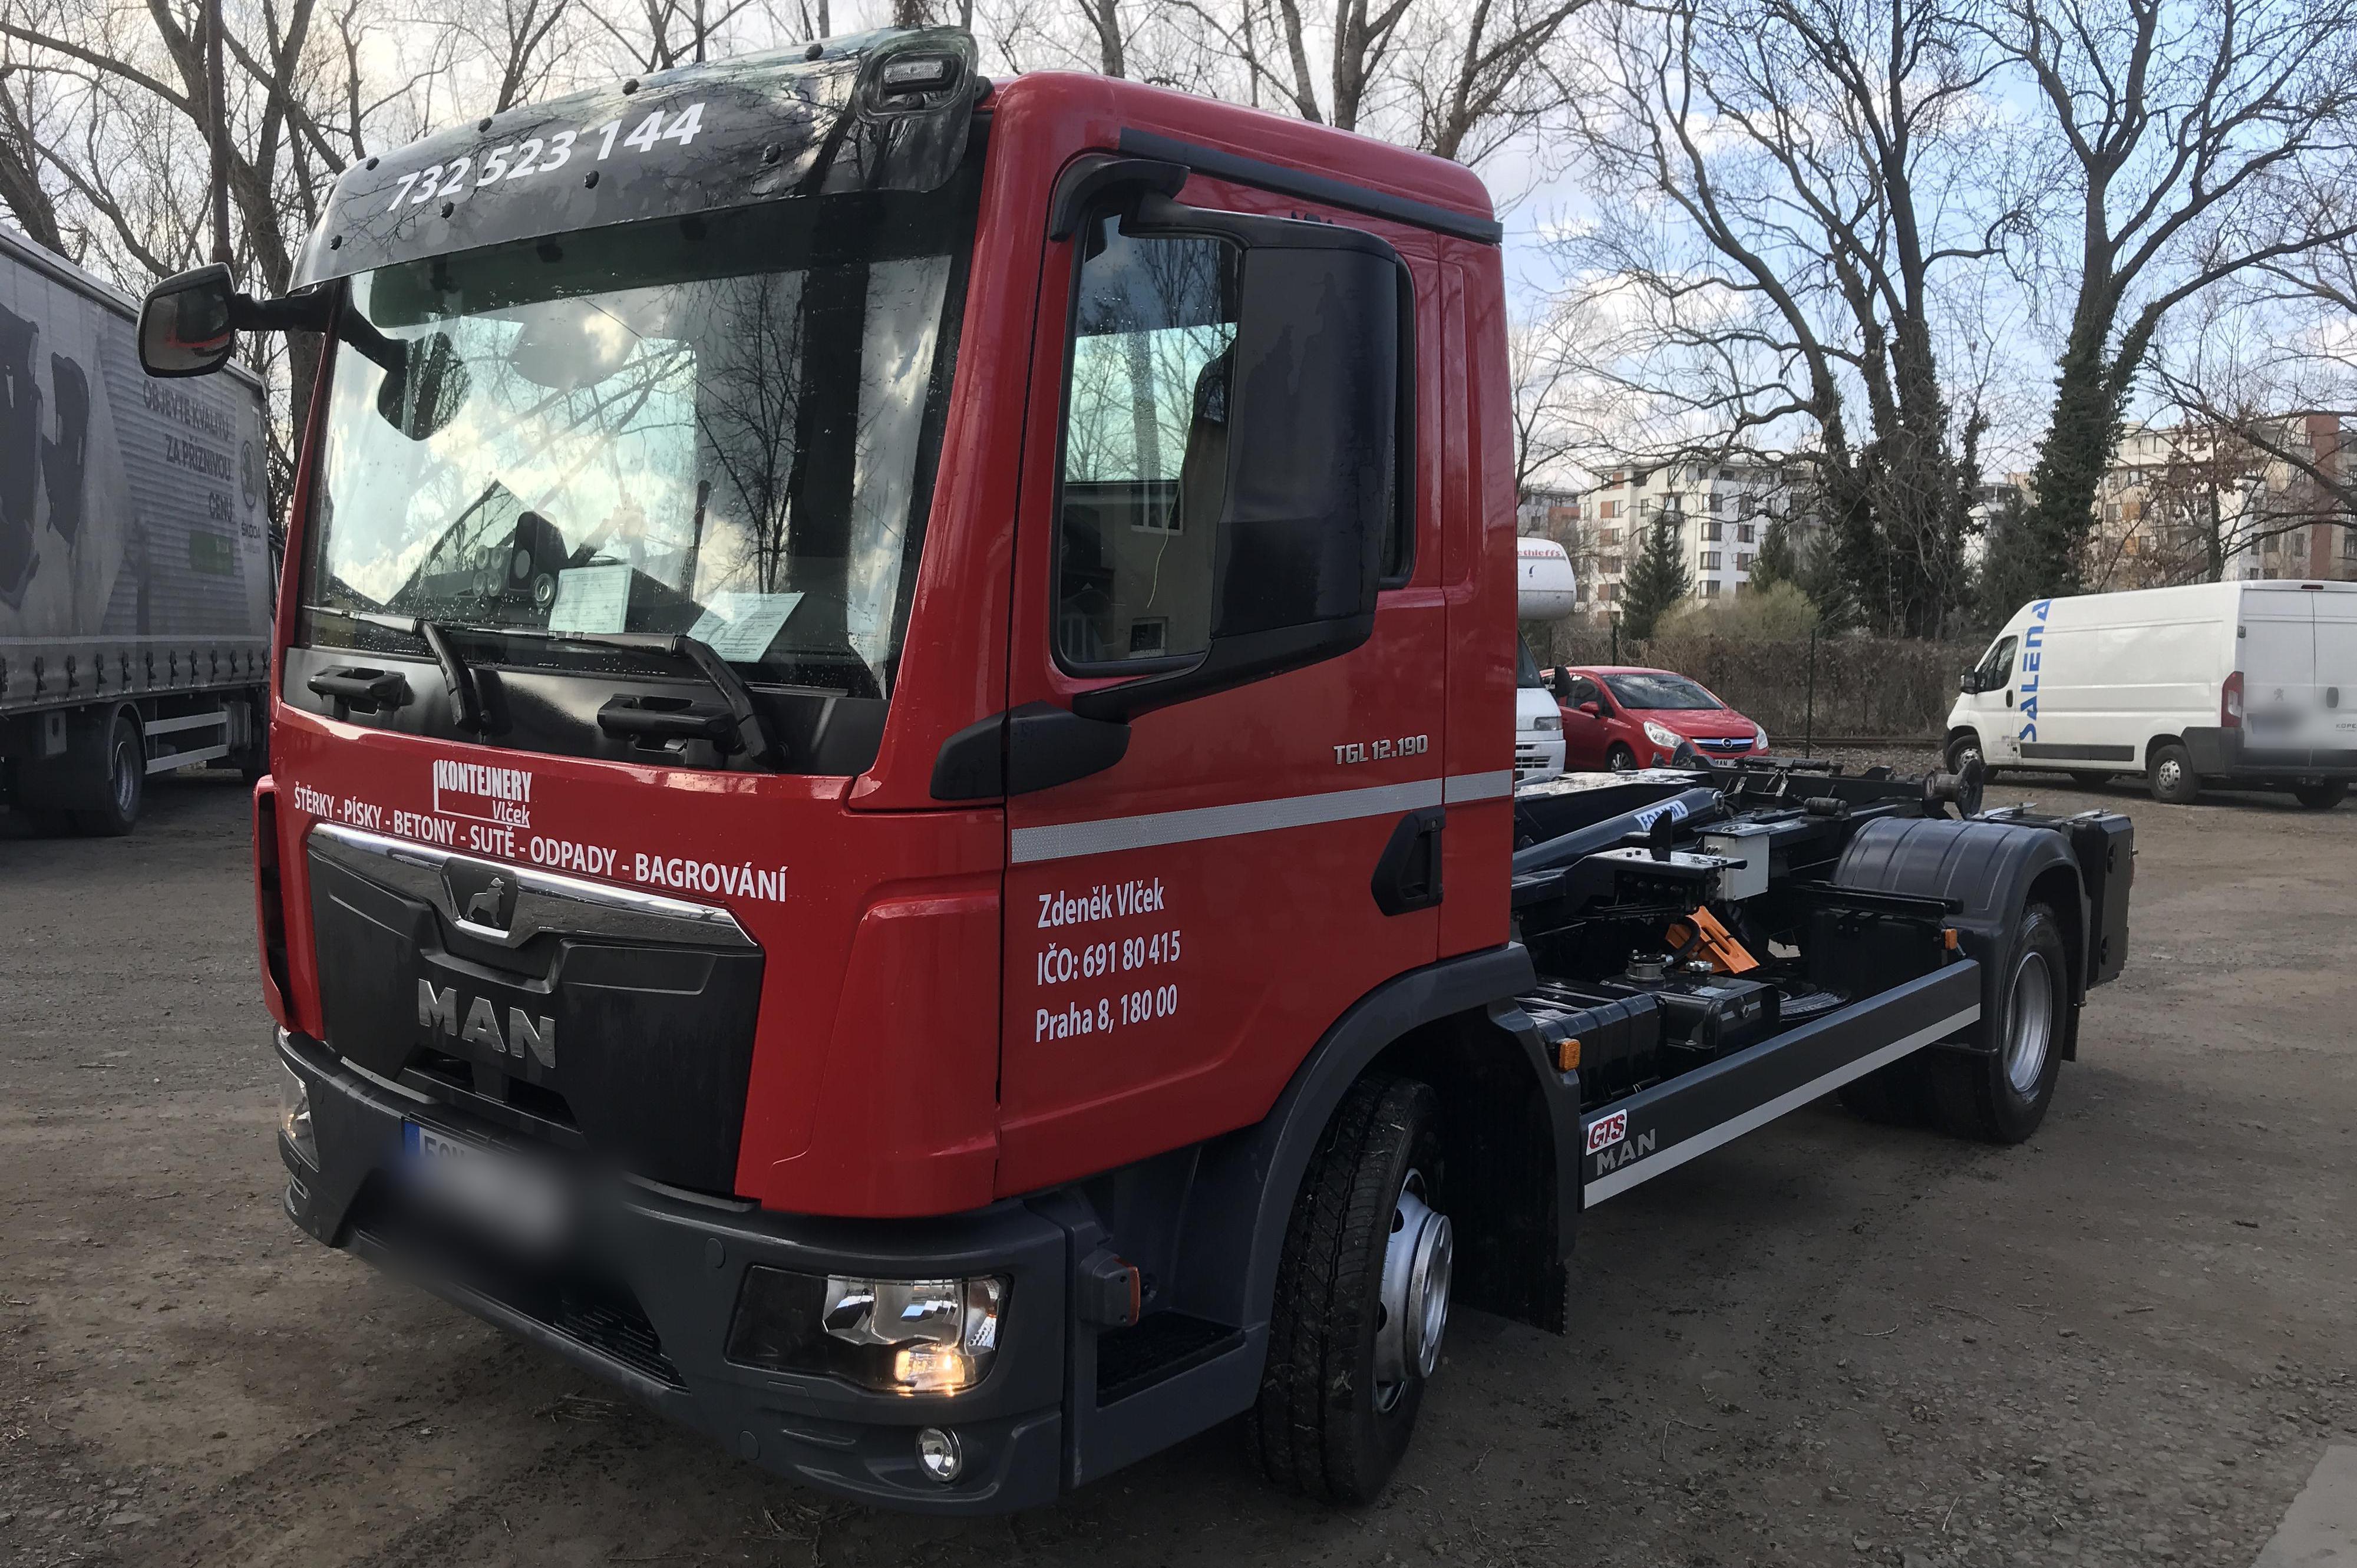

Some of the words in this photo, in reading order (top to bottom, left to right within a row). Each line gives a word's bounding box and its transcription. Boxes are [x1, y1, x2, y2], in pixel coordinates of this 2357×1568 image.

[387, 157, 471, 212] 732
[476, 130, 577, 187] 523
[597, 103, 706, 160] 144
[166, 433, 180, 465] ZA
[209, 491, 232, 522] CENU
[2018, 599, 2052, 742] SALENA
[1333, 743, 1368, 764] TGL
[1372, 734, 1428, 760] 12.190
[438, 759, 532, 803] KONTEJNERY
[492, 800, 530, 824] Vlček
[1640, 803, 1685, 828] FOAL
[295, 781, 335, 818] ŠTĚRKY
[345, 796, 382, 830] PÍSKY
[394, 810, 457, 846] BETONY
[470, 825, 516, 858] SUTĚ
[530, 836, 618, 876] ODPADY
[635, 853, 788, 902] BAGROVÁNÍ
[1038, 884, 1113, 928] Zdeněk
[1116, 877, 1164, 916] Vlček
[1038, 942, 1078, 985] IČO:
[1083, 942, 1116, 978] 691
[1123, 936, 1145, 970] 80
[1149, 930, 1180, 964] 415
[417, 979, 556, 1068] MAN
[1036, 1001, 1092, 1042] Praha
[1097, 998, 1114, 1034] 8,
[1121, 989, 1152, 1025] 180
[1156, 983, 1177, 1017] 00
[1589, 1113, 1625, 1150] GTS
[1597, 1128, 1656, 1176] MAN
